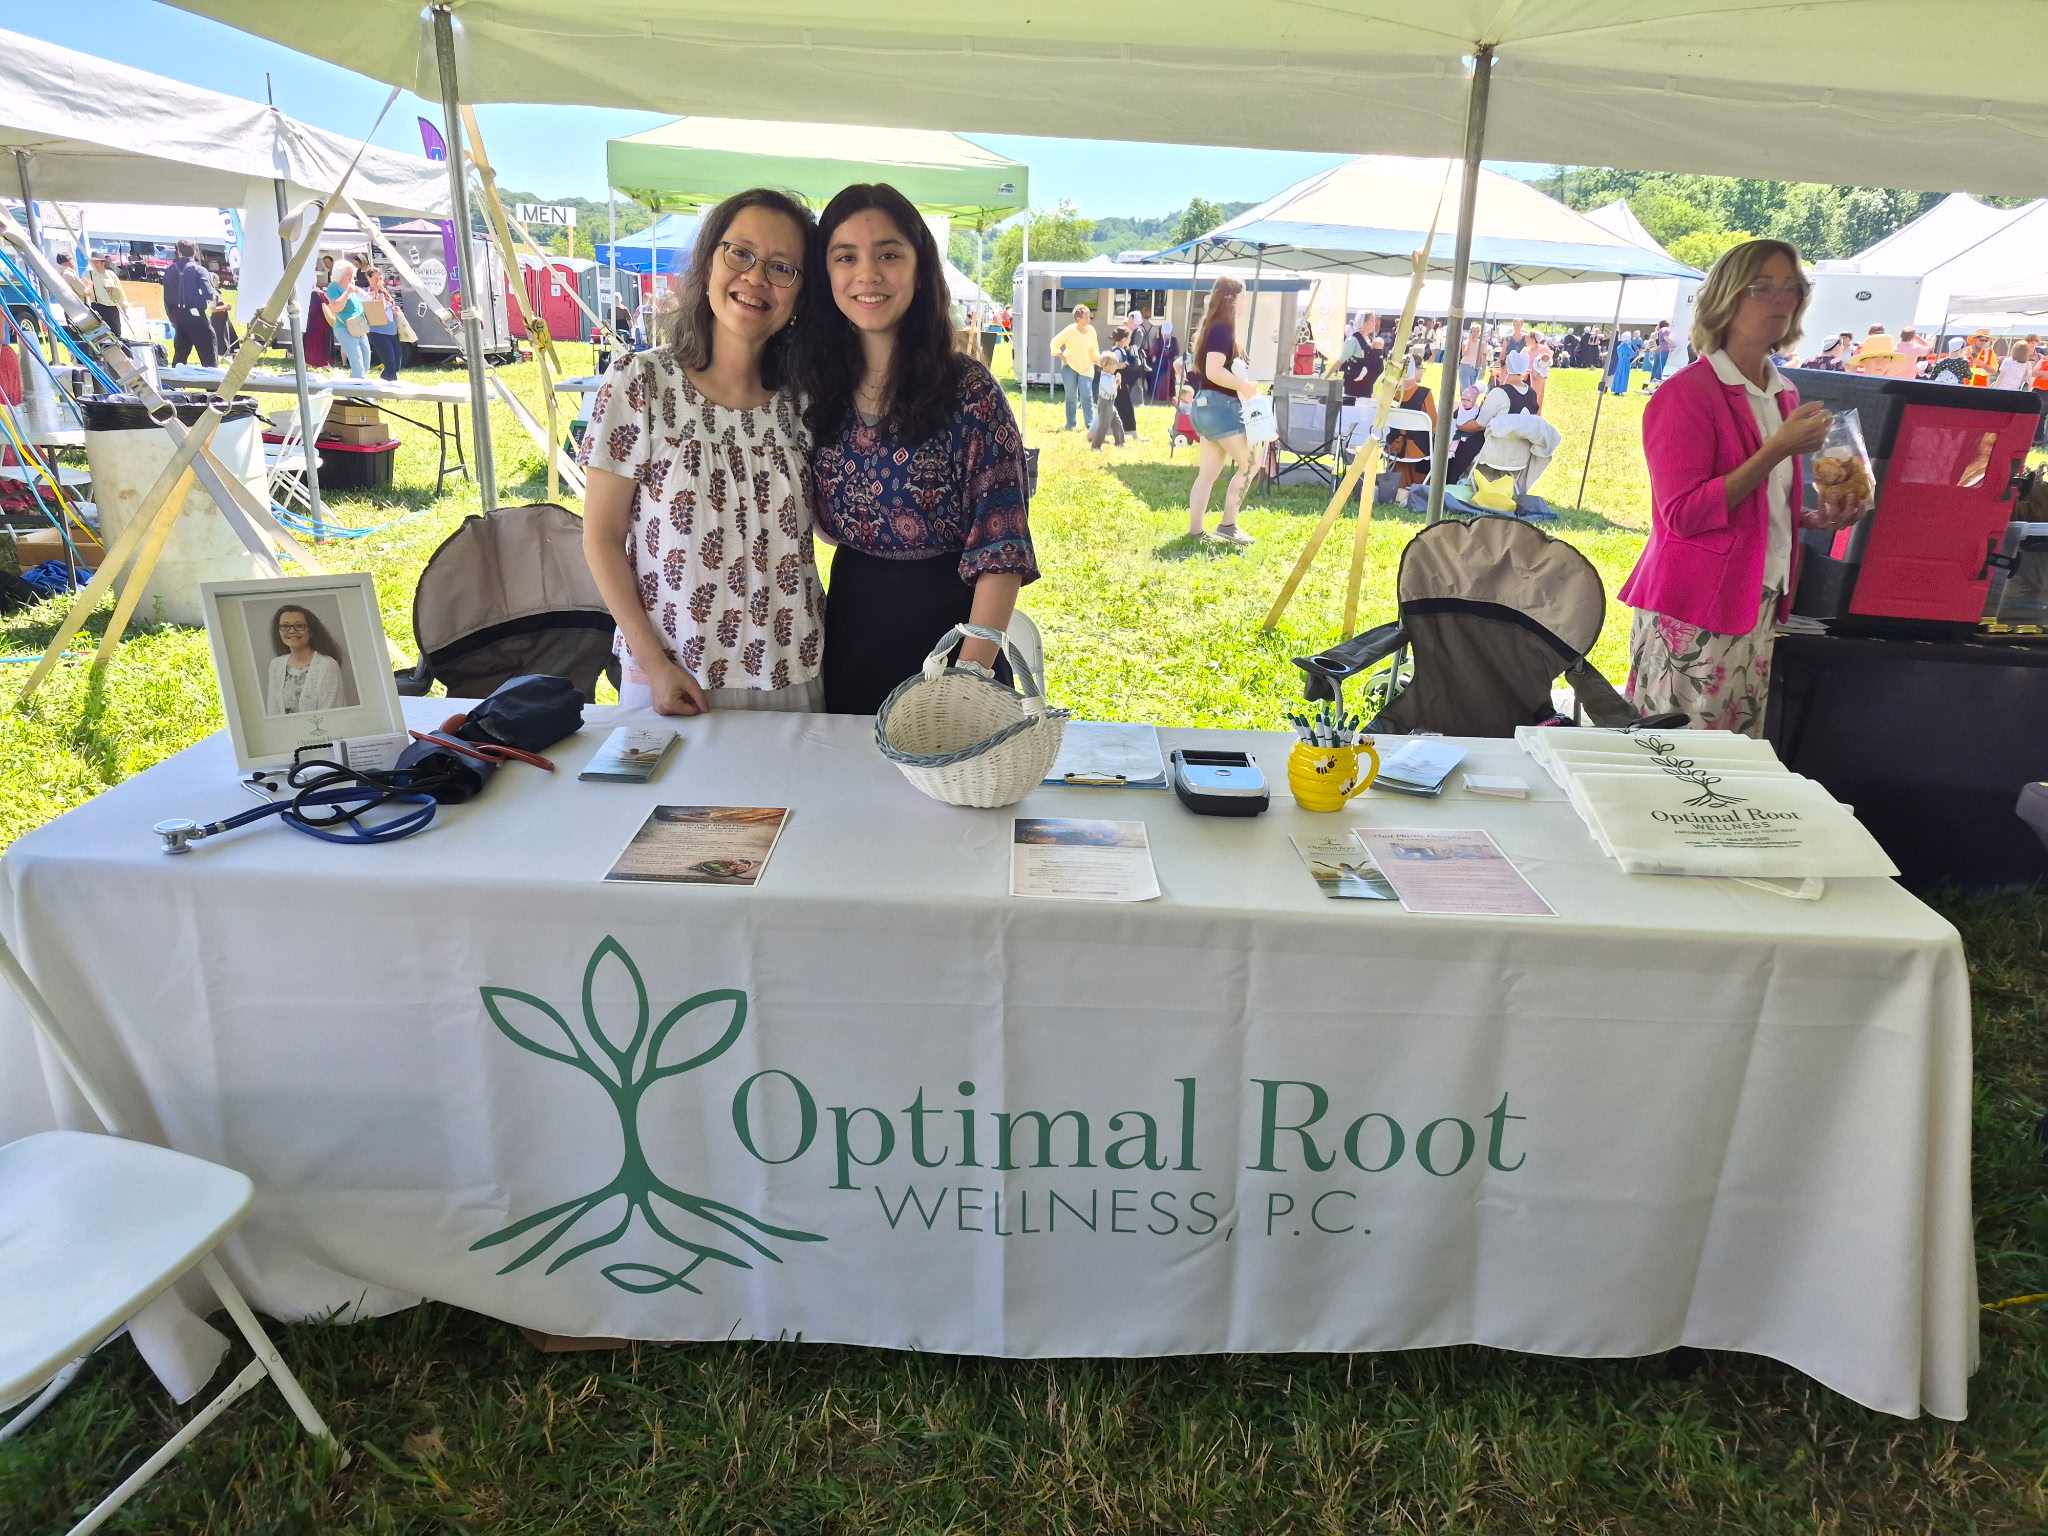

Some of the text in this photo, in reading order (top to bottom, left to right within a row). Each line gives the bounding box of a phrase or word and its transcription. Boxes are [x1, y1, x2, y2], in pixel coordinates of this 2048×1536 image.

[523, 205, 567, 224] MEN
[1651, 808, 1802, 824] Optimal Root
[1692, 821, 1771, 831] WELLNESS
[732, 1069, 1527, 1190] Optimal Root
[874, 1184, 1372, 1242] WELLNESS, P.C.
